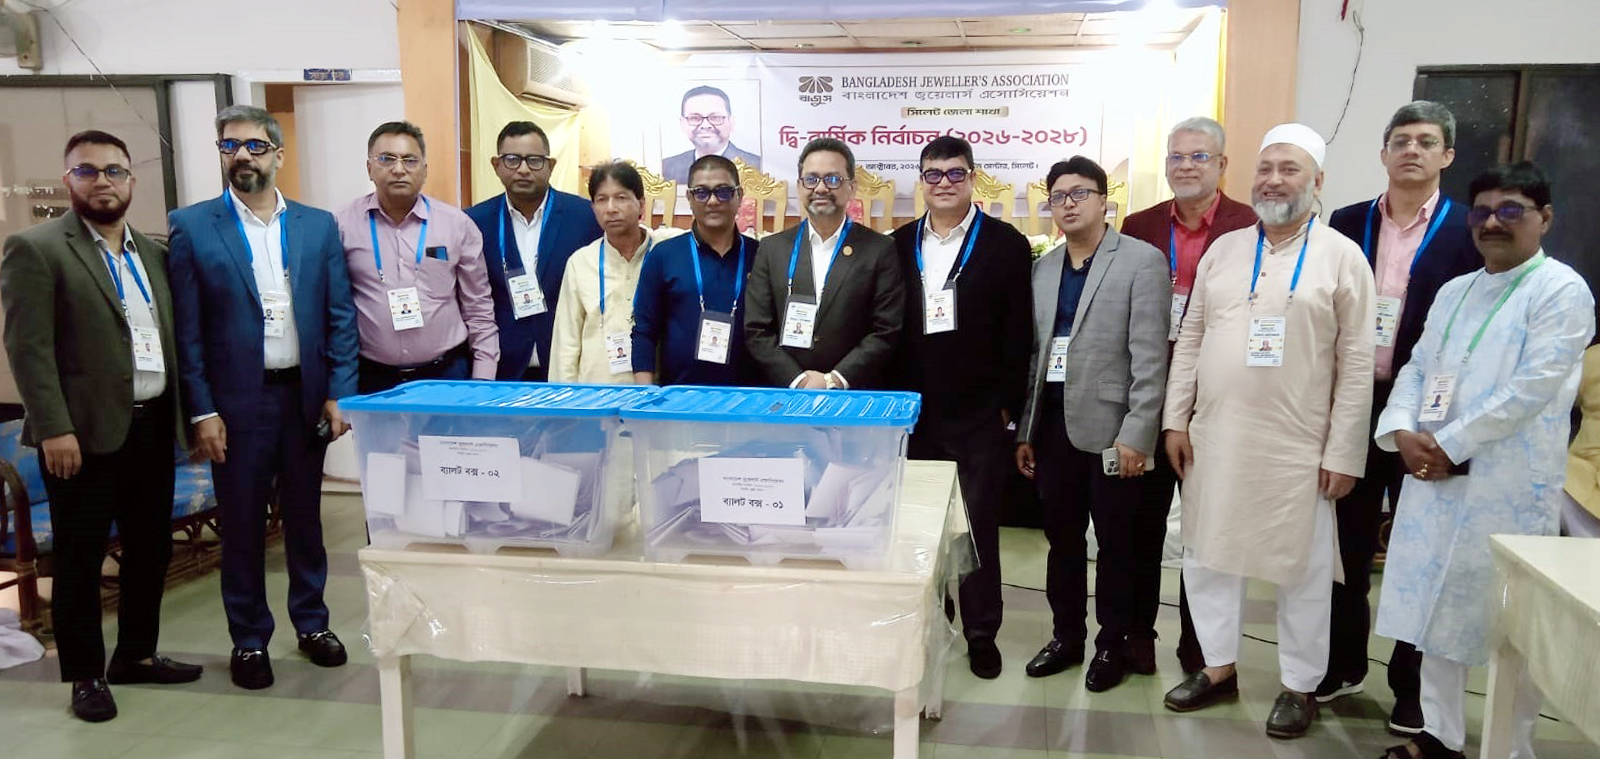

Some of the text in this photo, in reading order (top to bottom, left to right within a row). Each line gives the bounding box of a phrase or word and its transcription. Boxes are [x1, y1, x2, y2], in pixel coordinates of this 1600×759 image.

[841, 73, 1069, 88] BANGLADESH JEWELLER'S ASSOCIATION
[799, 95, 832, 107] বাজুস
[841, 88, 1069, 101] বাংলাদেশ জুয়েলার্স এসোসিয়েশন
[907, 107, 940, 116] সিলেট
[943, 107, 972, 116] জেলা
[871, 125, 940, 145] নির্বাচন
[440, 465, 462, 475] ব্যালট
[464, 467, 479, 476] বক্স
[488, 469, 500, 478] ০২
[723, 497, 746, 507] ব্যালট
[748, 499, 763, 509] বক্স
[772, 500, 784, 509] ০১
